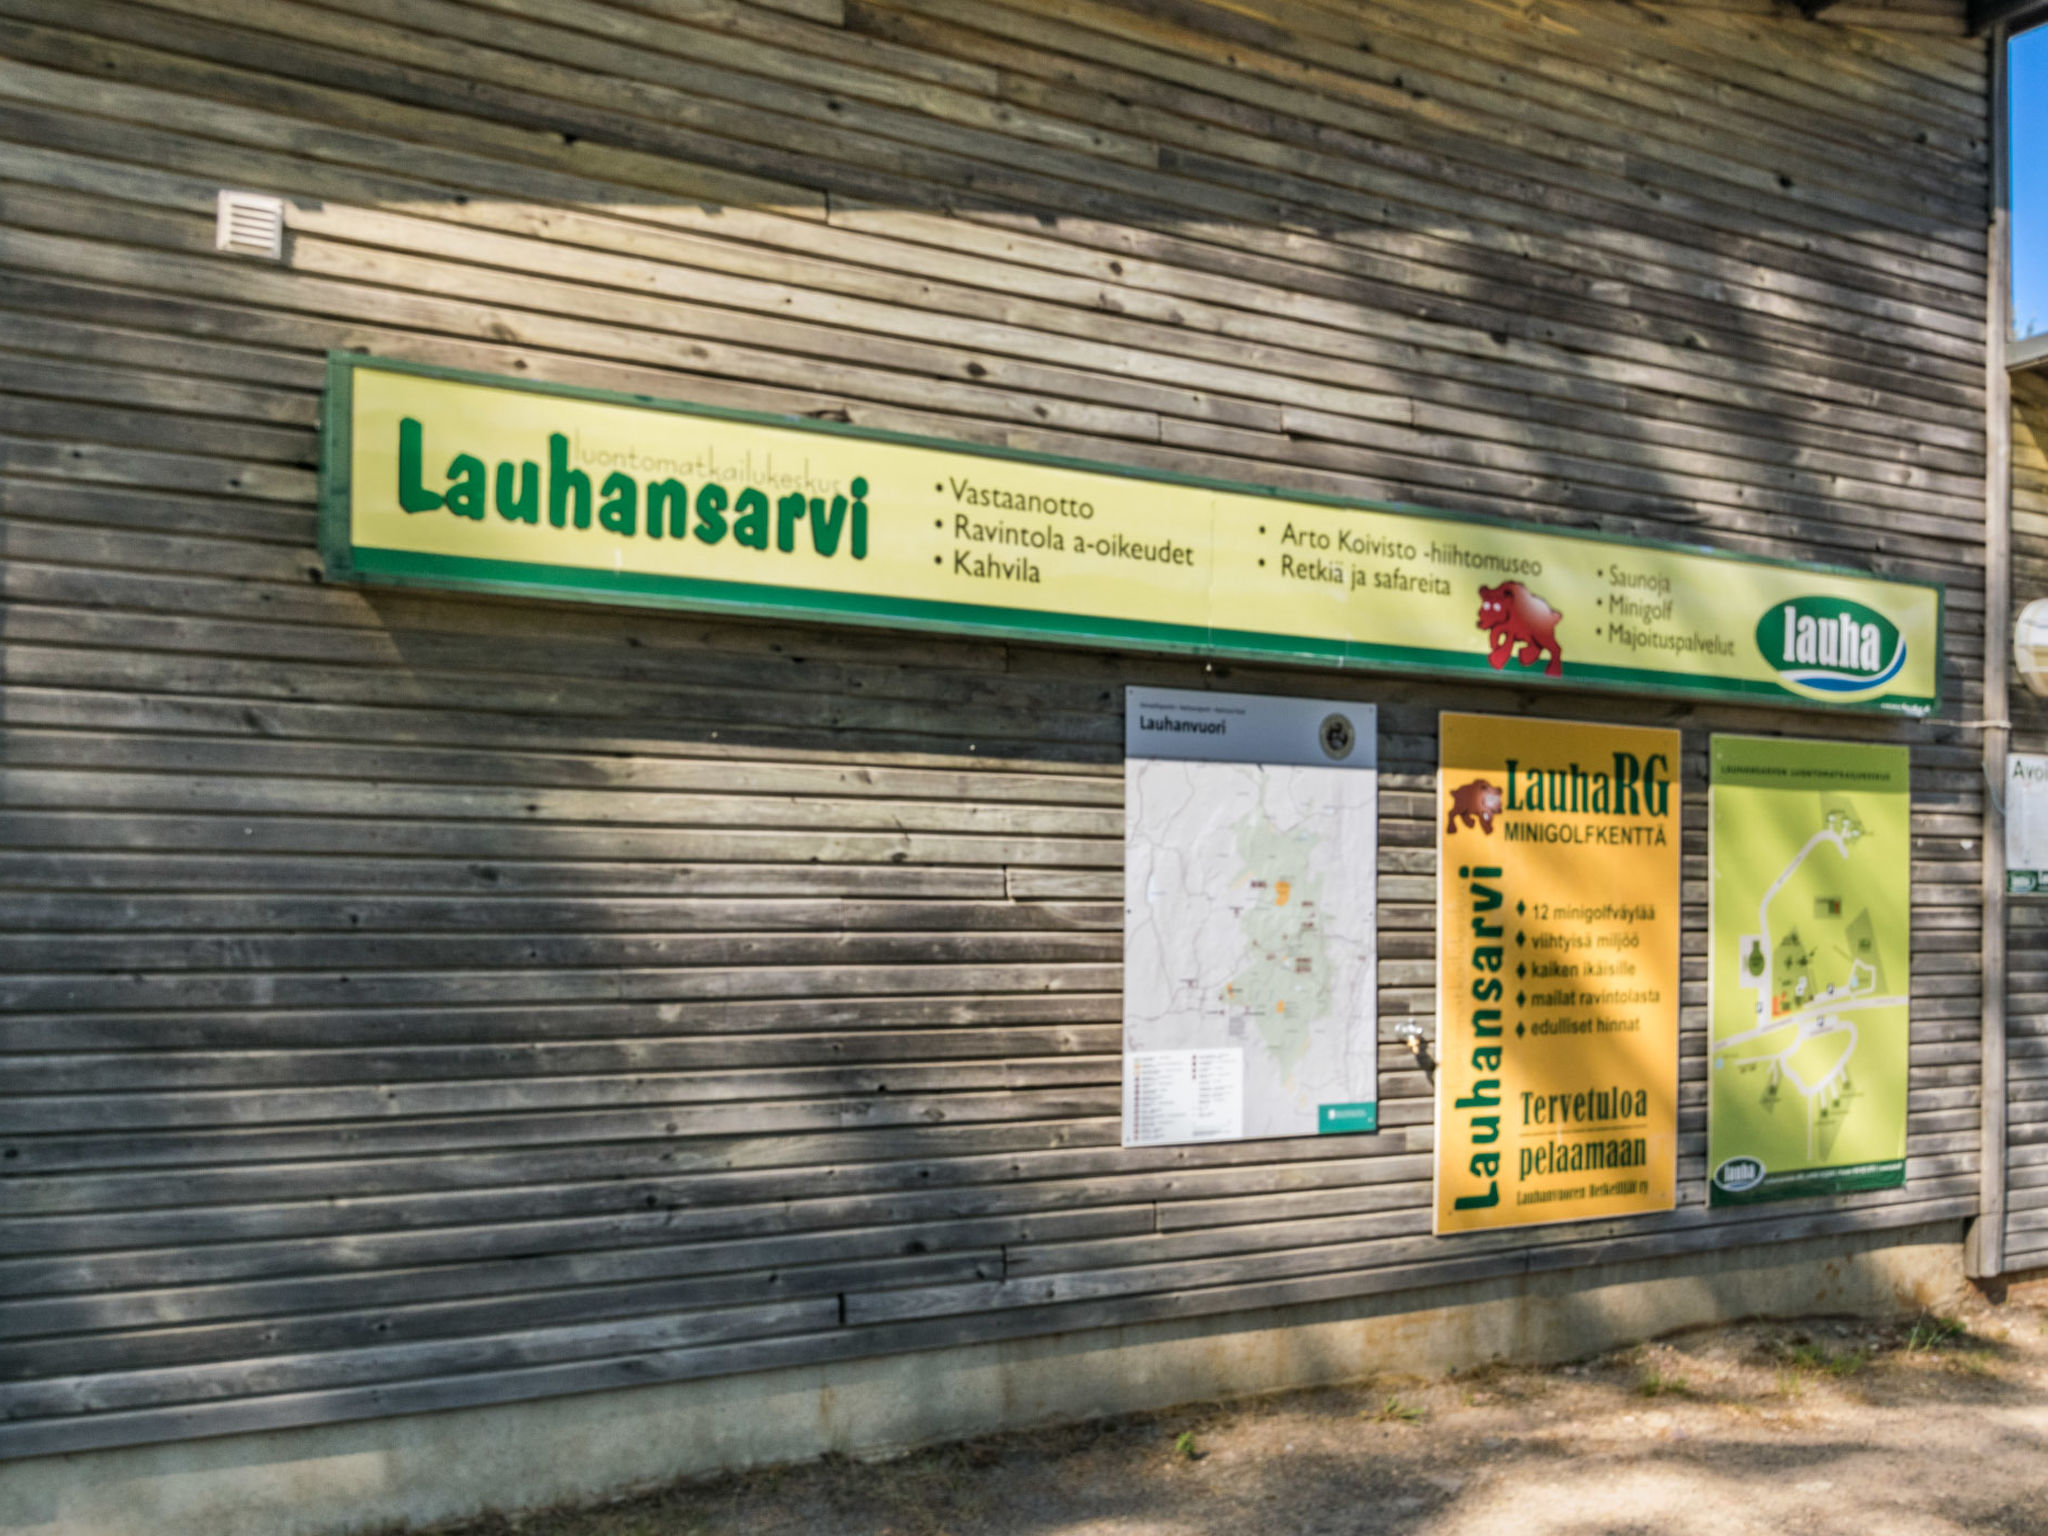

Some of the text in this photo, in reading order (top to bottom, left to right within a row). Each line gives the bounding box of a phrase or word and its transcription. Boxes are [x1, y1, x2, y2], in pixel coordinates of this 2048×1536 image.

[574, 427, 842, 494] luontomatkailukeskus
[399, 417, 868, 560] Lauhansarvi
[950, 476, 1094, 519] Vastaanotto
[955, 513, 1194, 566] Ravintola a-oikeudet
[1281, 523, 1543, 577] Arto Koivisto -hiihtomuseo
[954, 550, 1041, 583] Kahvila
[1282, 554, 1451, 596] Retkiä ja safareita
[1609, 565, 1671, 595] Saunoja
[1609, 595, 1672, 624] Minigolf
[1608, 624, 1735, 657] Majoituspalvelut
[1783, 606, 1881, 672] lauha
[1139, 715, 1226, 735] Lauhanvuori
[1505, 752, 1670, 818] LauhaRG
[1504, 822, 1667, 847] MINIGOLFKENTTÄ
[1533, 904, 1656, 924] 12 minigolfväylää
[1531, 932, 1639, 952] viihtyisä miljöö
[1531, 961, 1635, 978] kaiken ikäisille
[1531, 988, 1660, 1006] mailat ravintolasta
[1454, 865, 1503, 1211] Lauhansarvi
[1531, 1017, 1640, 1036] edulliset hinnat
[1520, 1086, 1647, 1125] Tervetuloa
[1519, 1138, 1646, 1181] pelaamaan
